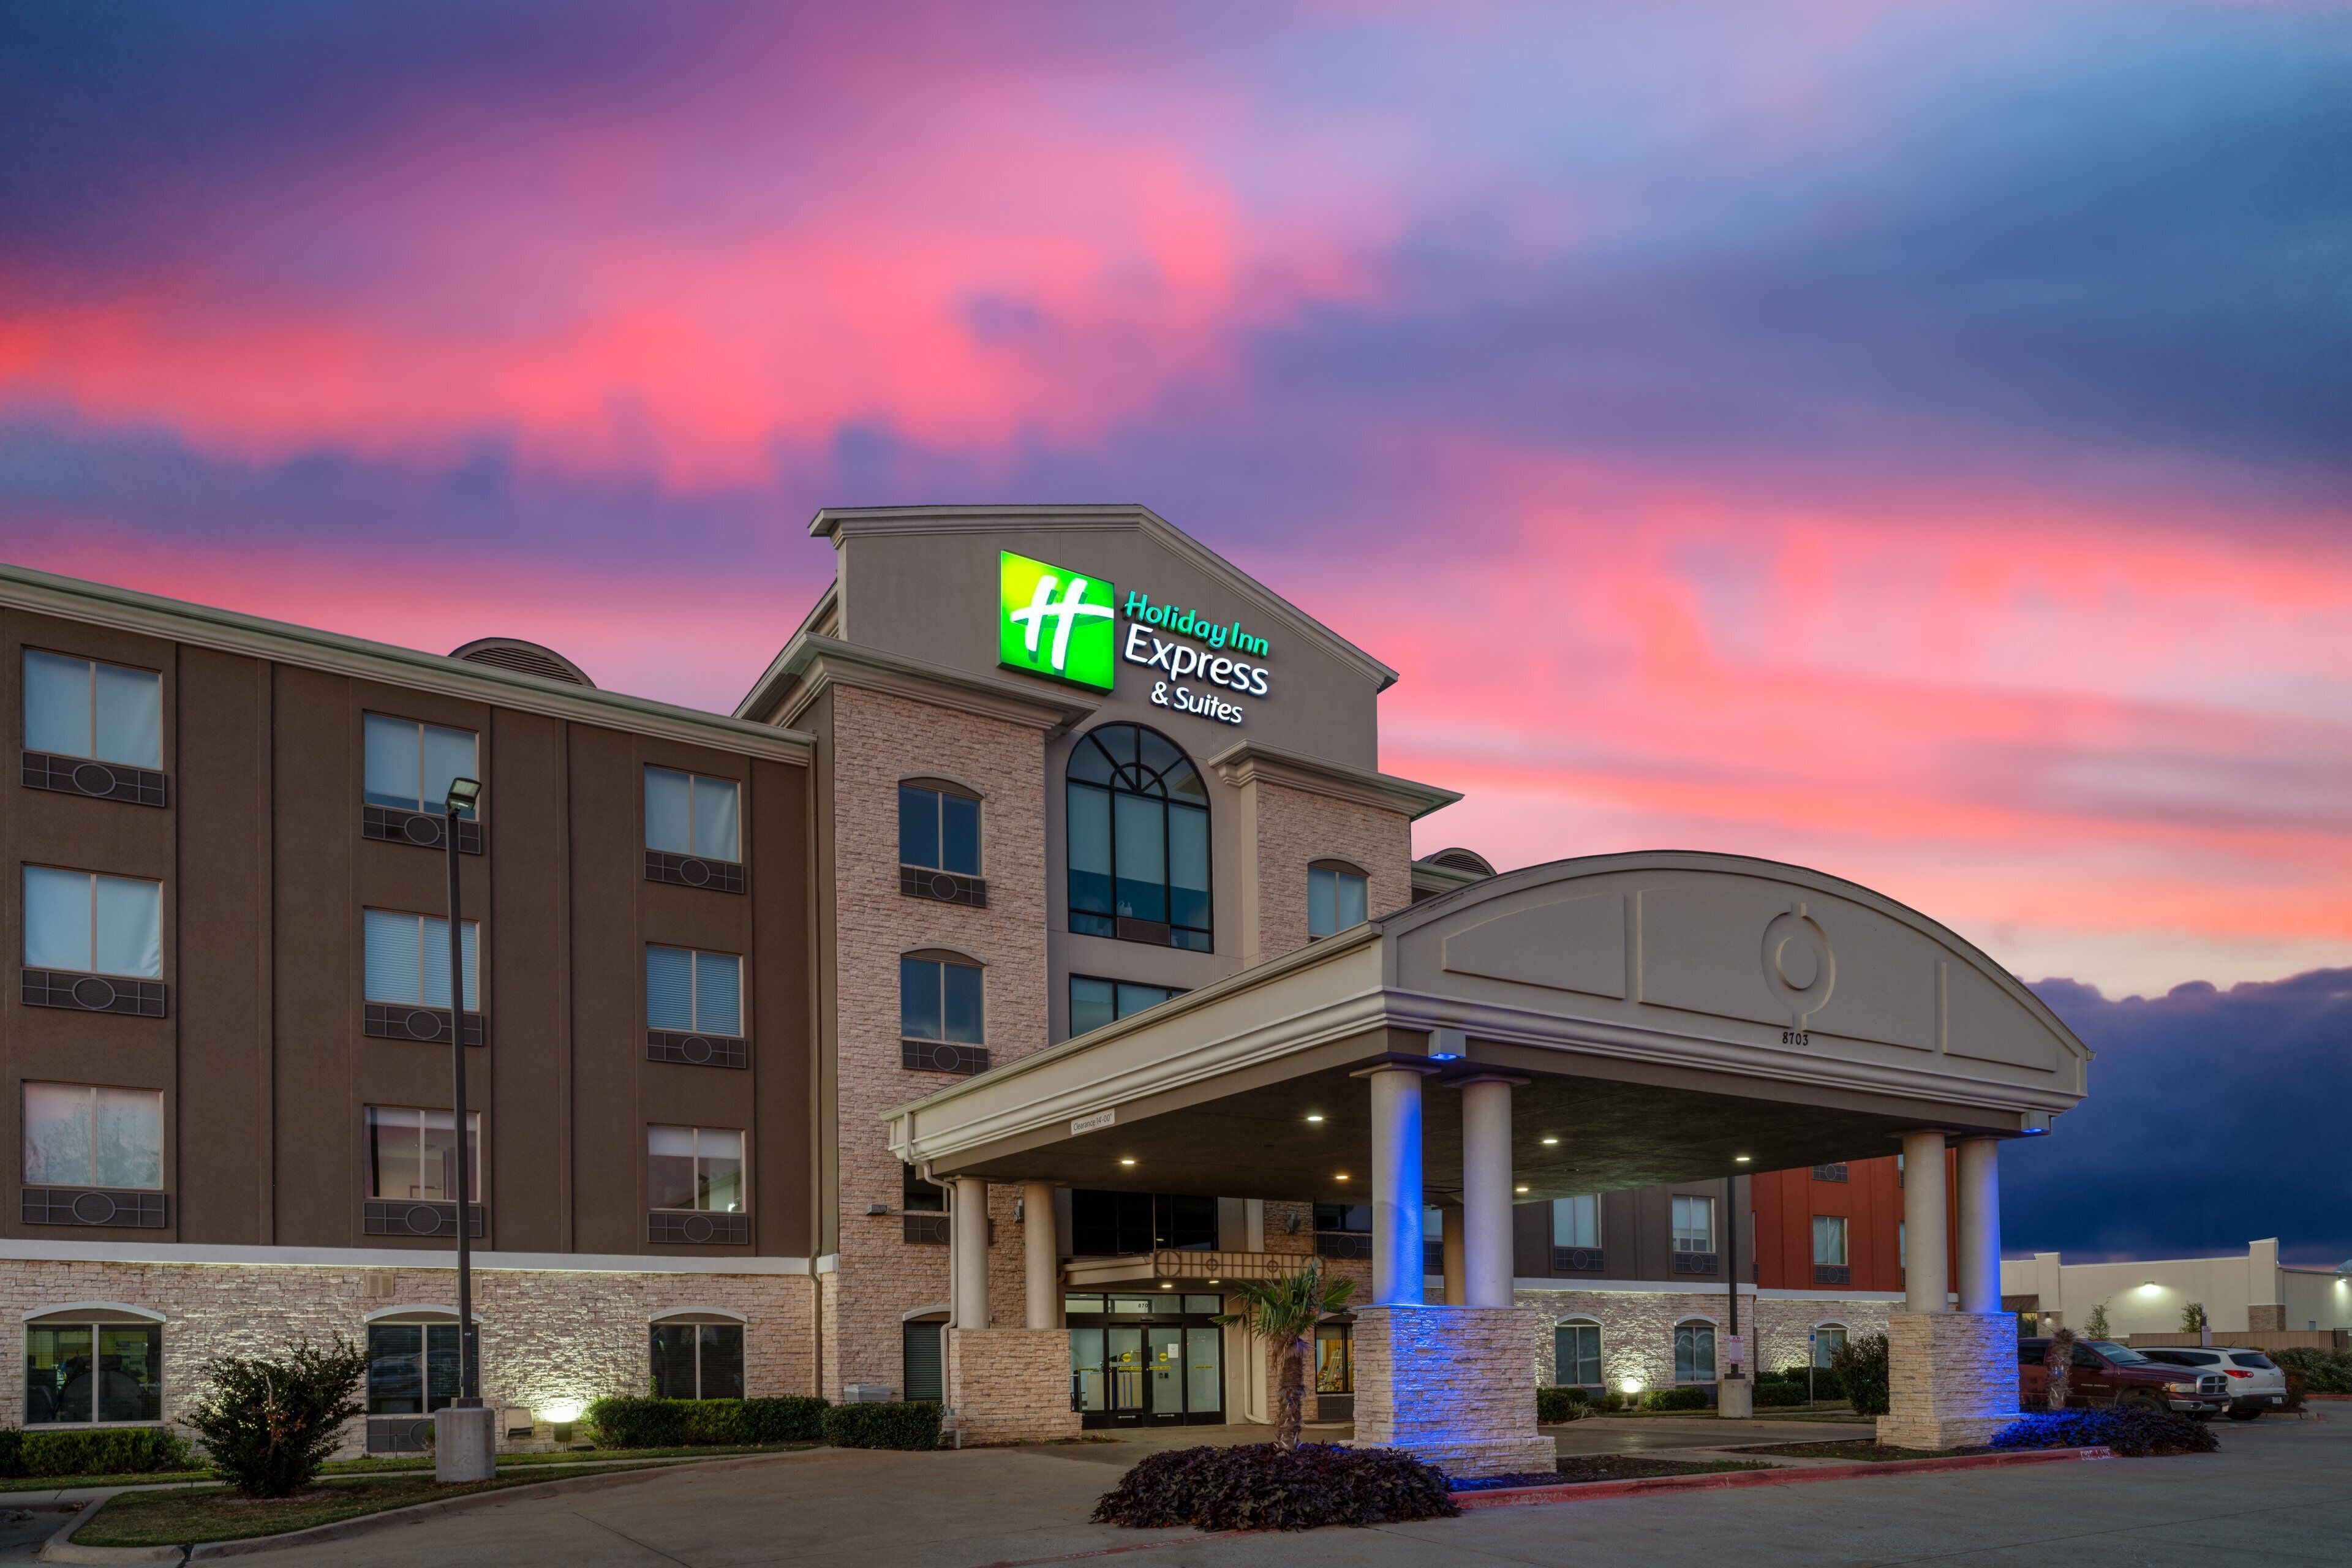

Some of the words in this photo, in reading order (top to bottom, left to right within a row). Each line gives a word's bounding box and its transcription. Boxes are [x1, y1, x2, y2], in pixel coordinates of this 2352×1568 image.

[1123, 590, 1227, 650] Holiday
[1227, 620, 1269, 657] Inn
[1123, 622, 1269, 696] Express
[1150, 680, 1169, 706] &
[1174, 686, 1243, 725] Suites
[1782, 1031, 1808, 1046] 8703
[1073, 1120, 1096, 1131] Clearance
